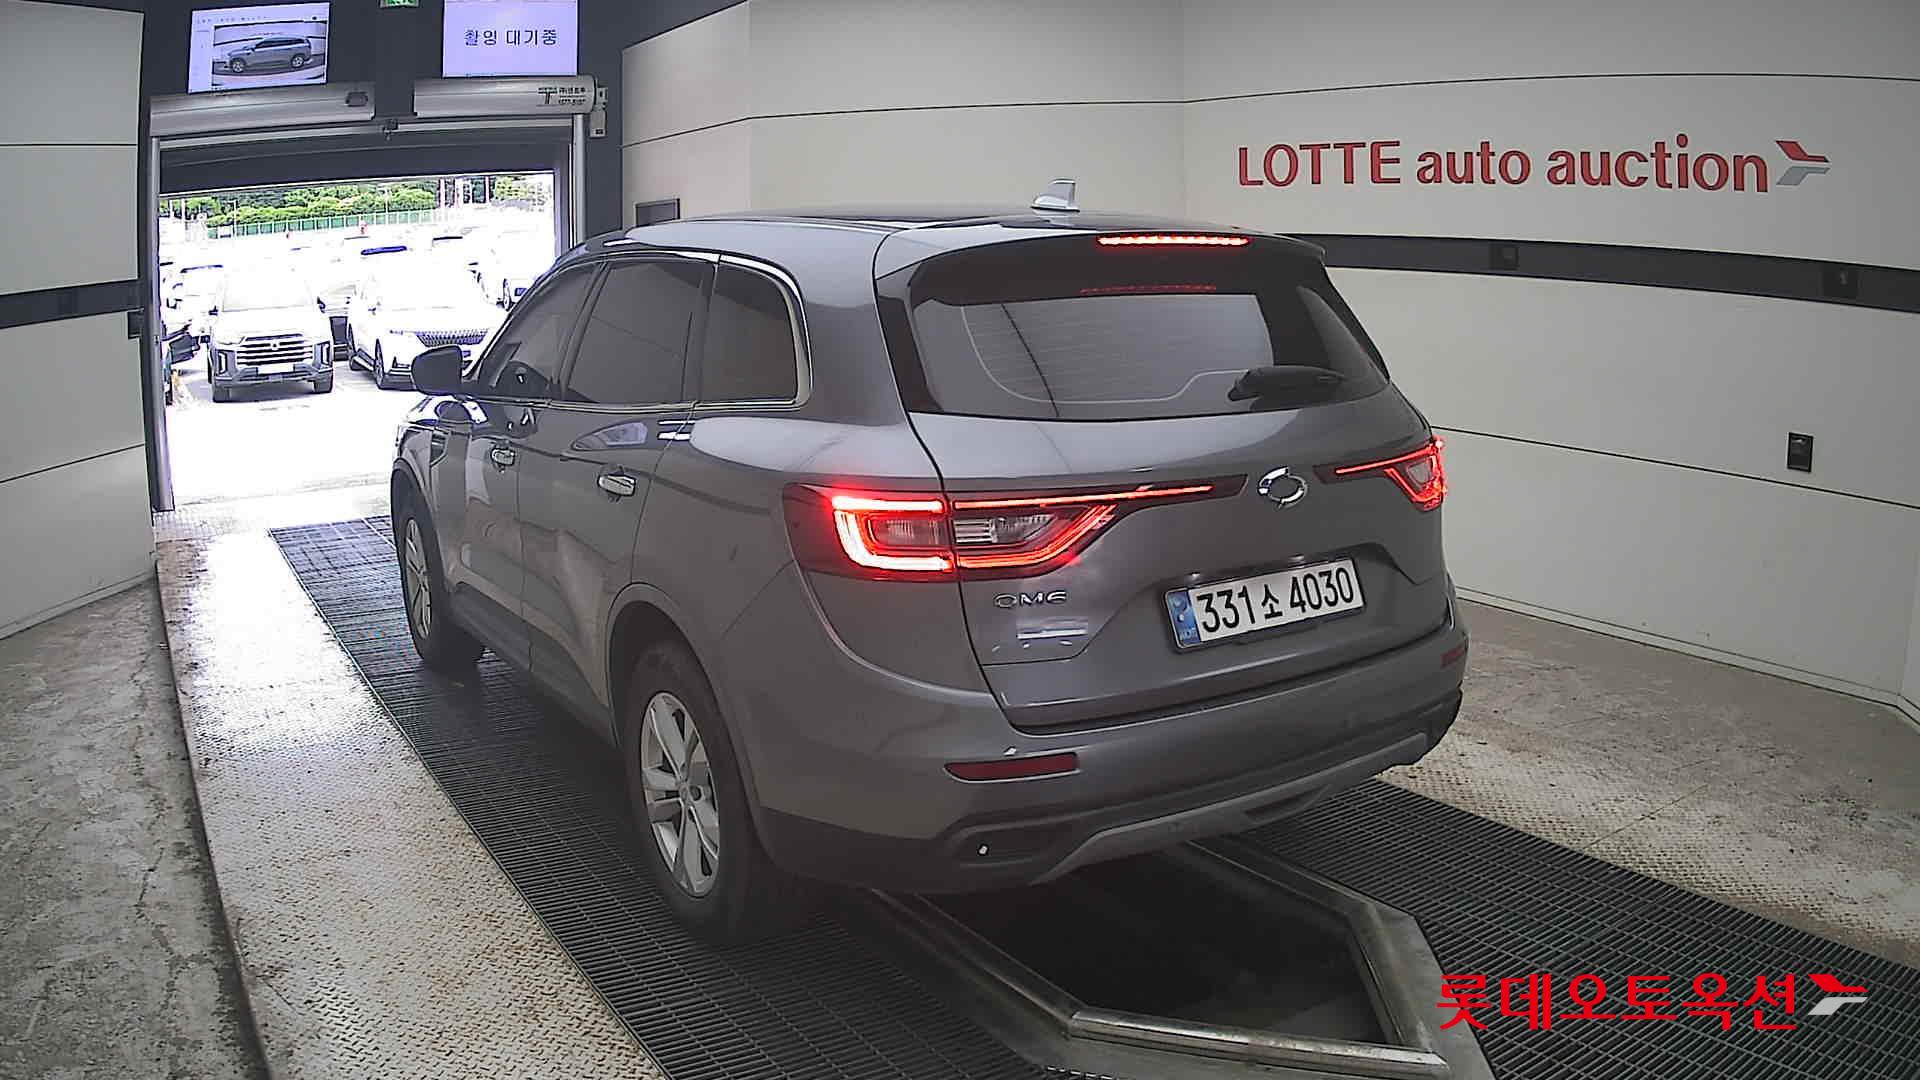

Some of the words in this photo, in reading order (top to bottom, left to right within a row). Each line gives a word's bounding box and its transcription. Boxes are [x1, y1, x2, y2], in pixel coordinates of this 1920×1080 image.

[505, 28, 557, 46] 대기중
[1238, 140, 1401, 187] LOTTE
[1416, 141, 1532, 186] auto
[1546, 134, 1769, 192] auction
[994, 591, 1067, 608] QM6
